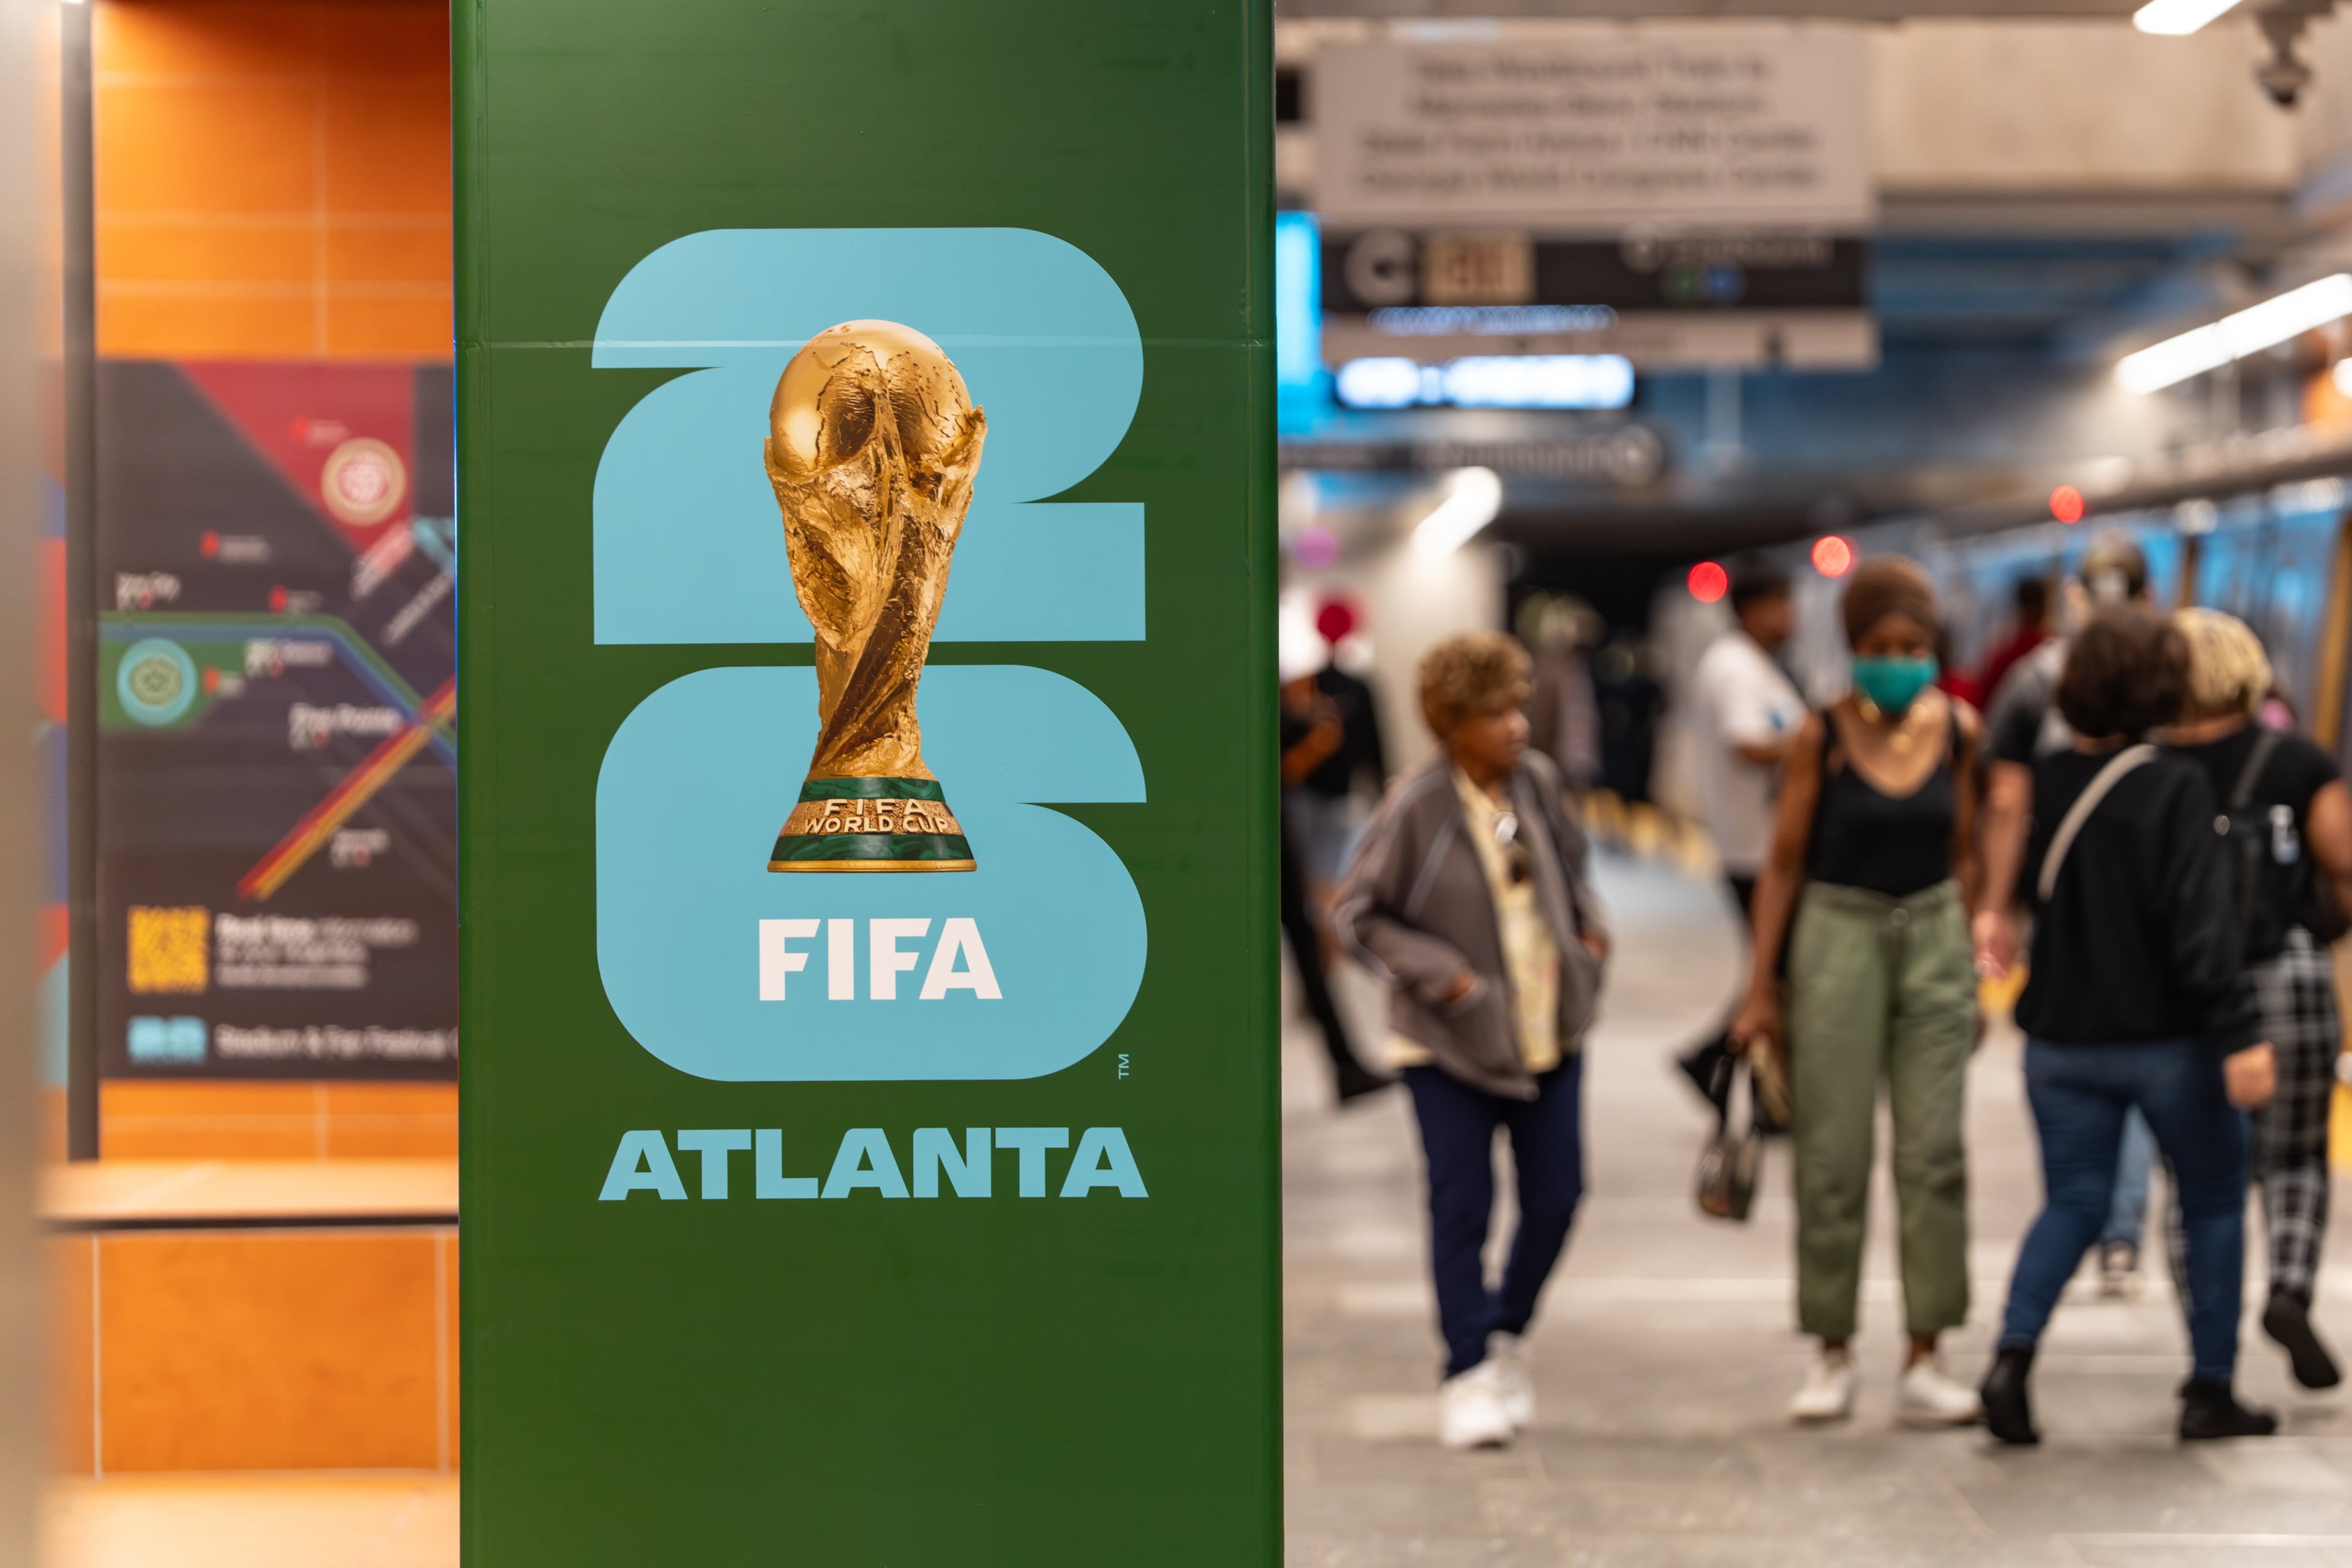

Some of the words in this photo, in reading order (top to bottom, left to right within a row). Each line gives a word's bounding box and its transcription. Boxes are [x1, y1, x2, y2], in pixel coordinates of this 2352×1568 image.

[824, 798, 929, 817] FIFA
[804, 816, 894, 834] WORLD
[901, 816, 949, 834] CUP
[758, 917, 1004, 1001] FIFA
[1118, 1054, 1130, 1080] TM
[598, 1126, 1150, 1201] ATLANTA
